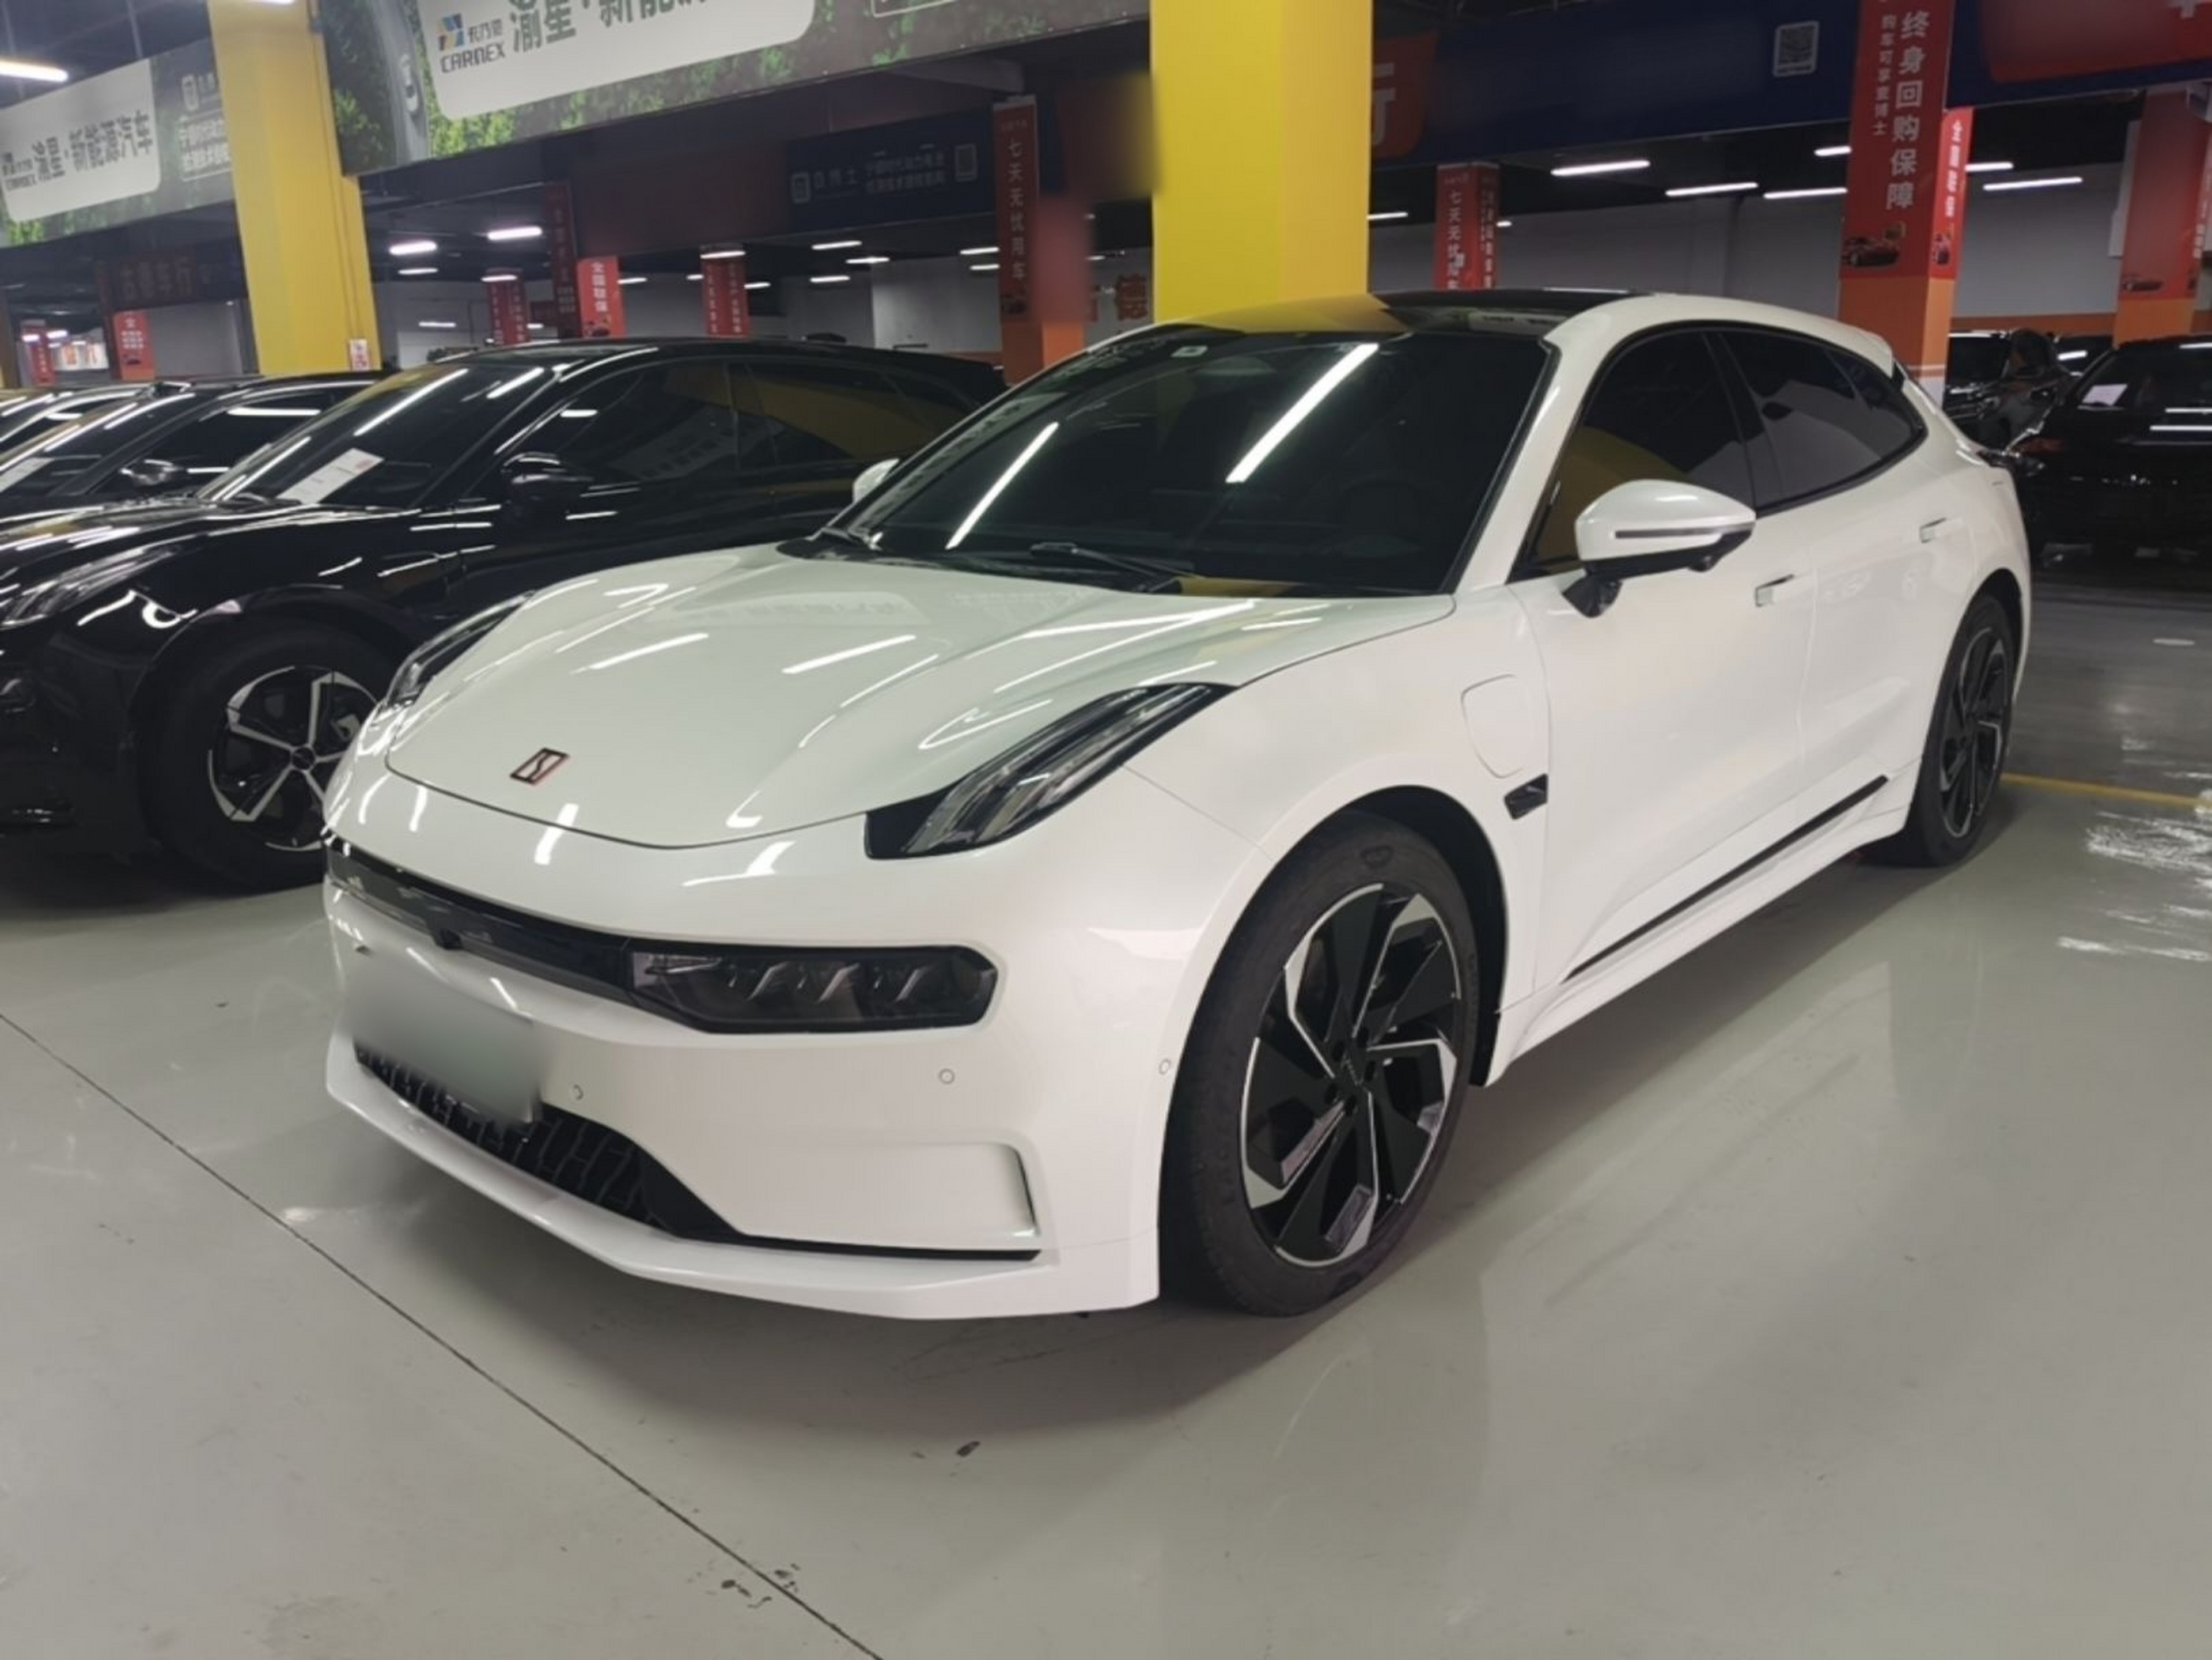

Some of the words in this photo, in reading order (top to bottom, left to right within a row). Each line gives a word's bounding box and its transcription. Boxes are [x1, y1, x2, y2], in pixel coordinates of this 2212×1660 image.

[440, 41, 506, 73] CARNEX
[1887, 11, 1929, 210] 终身回购保障
